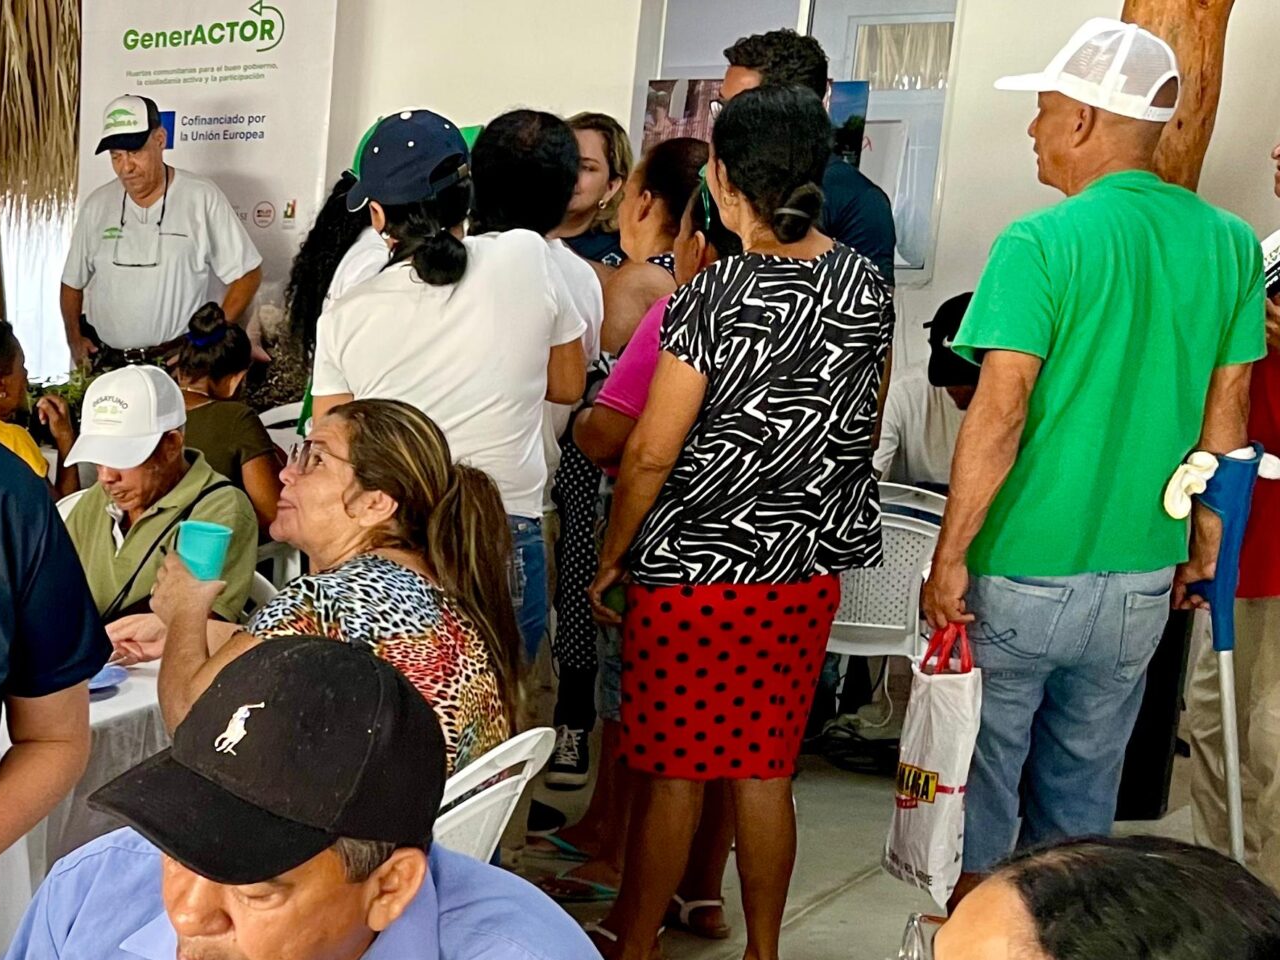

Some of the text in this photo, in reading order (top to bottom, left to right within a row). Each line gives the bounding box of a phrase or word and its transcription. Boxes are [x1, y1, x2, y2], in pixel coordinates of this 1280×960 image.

[123, 19, 275, 50] GenerACTOR
[180, 113, 266, 126] Cofinanciado por
[179, 129, 264, 141] la Unión Europea
